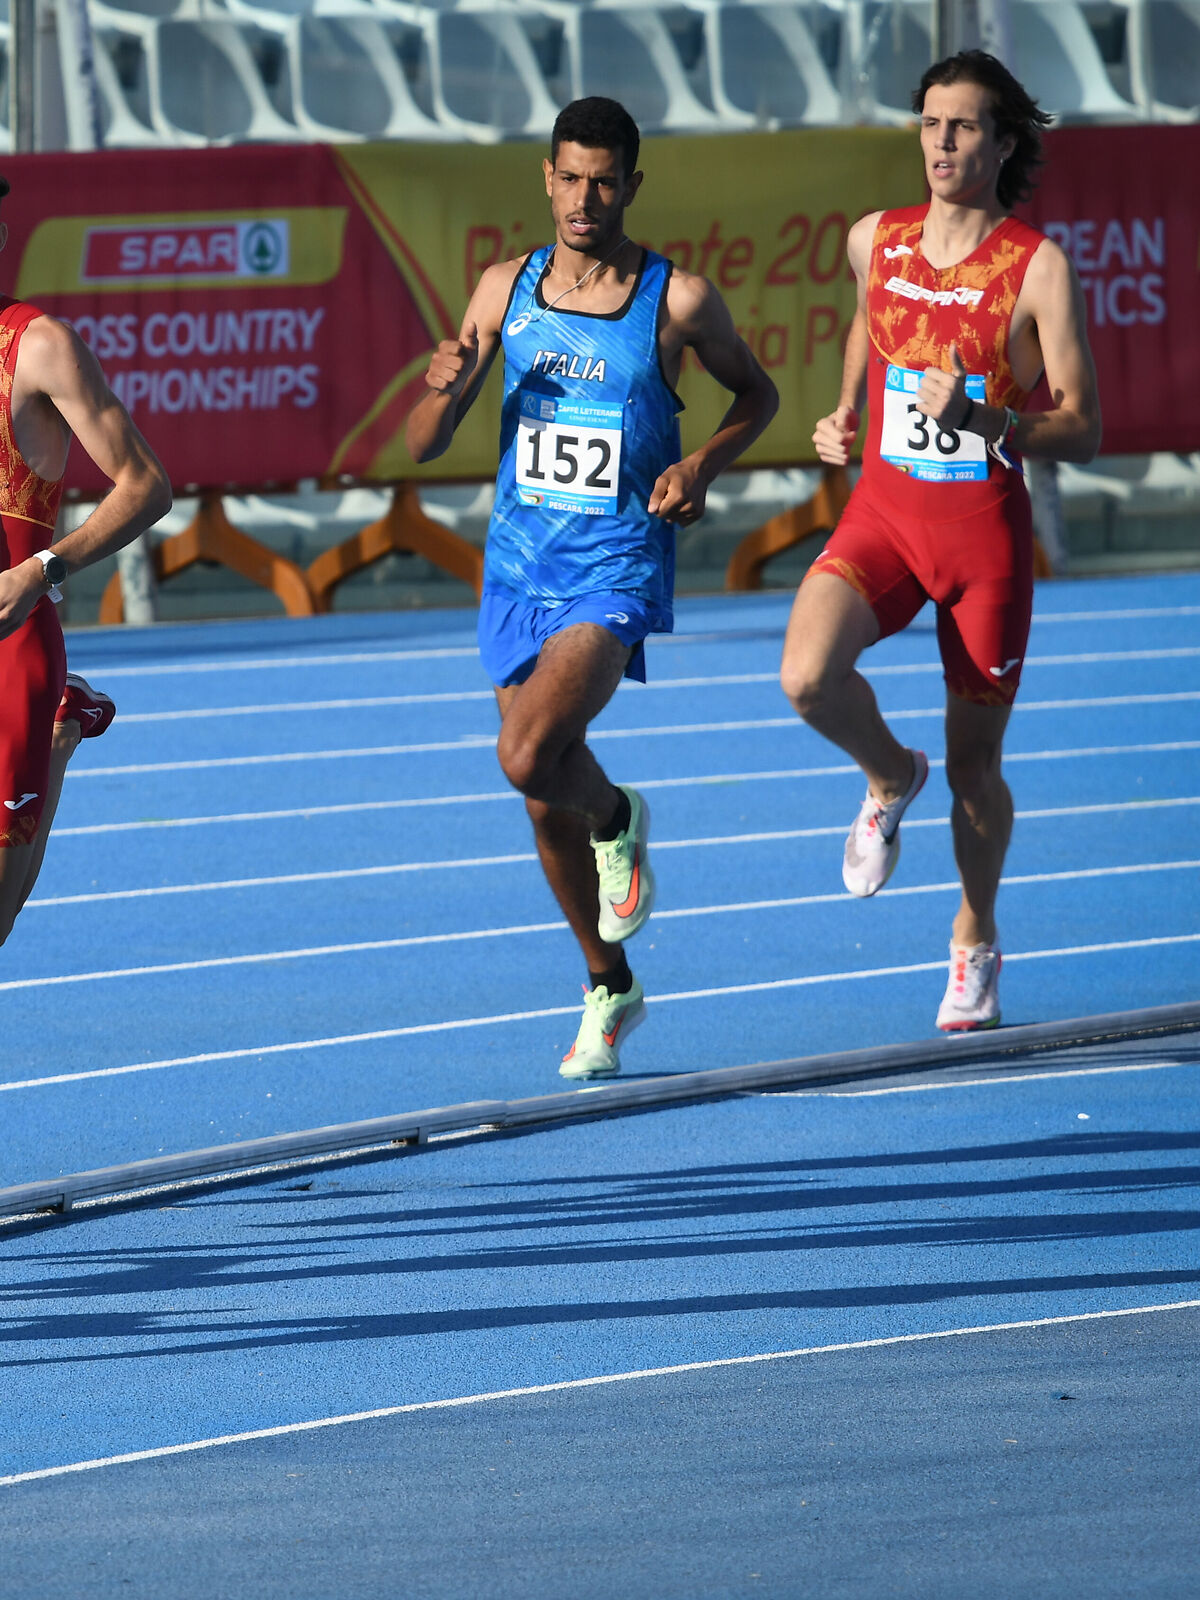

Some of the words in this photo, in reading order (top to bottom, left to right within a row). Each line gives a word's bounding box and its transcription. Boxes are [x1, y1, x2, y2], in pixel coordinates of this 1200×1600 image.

[119, 232, 236, 270] SPAR
[1042, 217, 1165, 271] PEAN
[884, 276, 984, 306] ESPAÑA
[60, 314, 138, 358] OSS
[142, 306, 325, 357] COUNTRY
[531, 350, 606, 383] ITALIA
[907, 403, 961, 455] 38
[525, 430, 612, 489] 152
[548, 501, 582, 514] PESCARA
[584, 506, 605, 515] 2022
